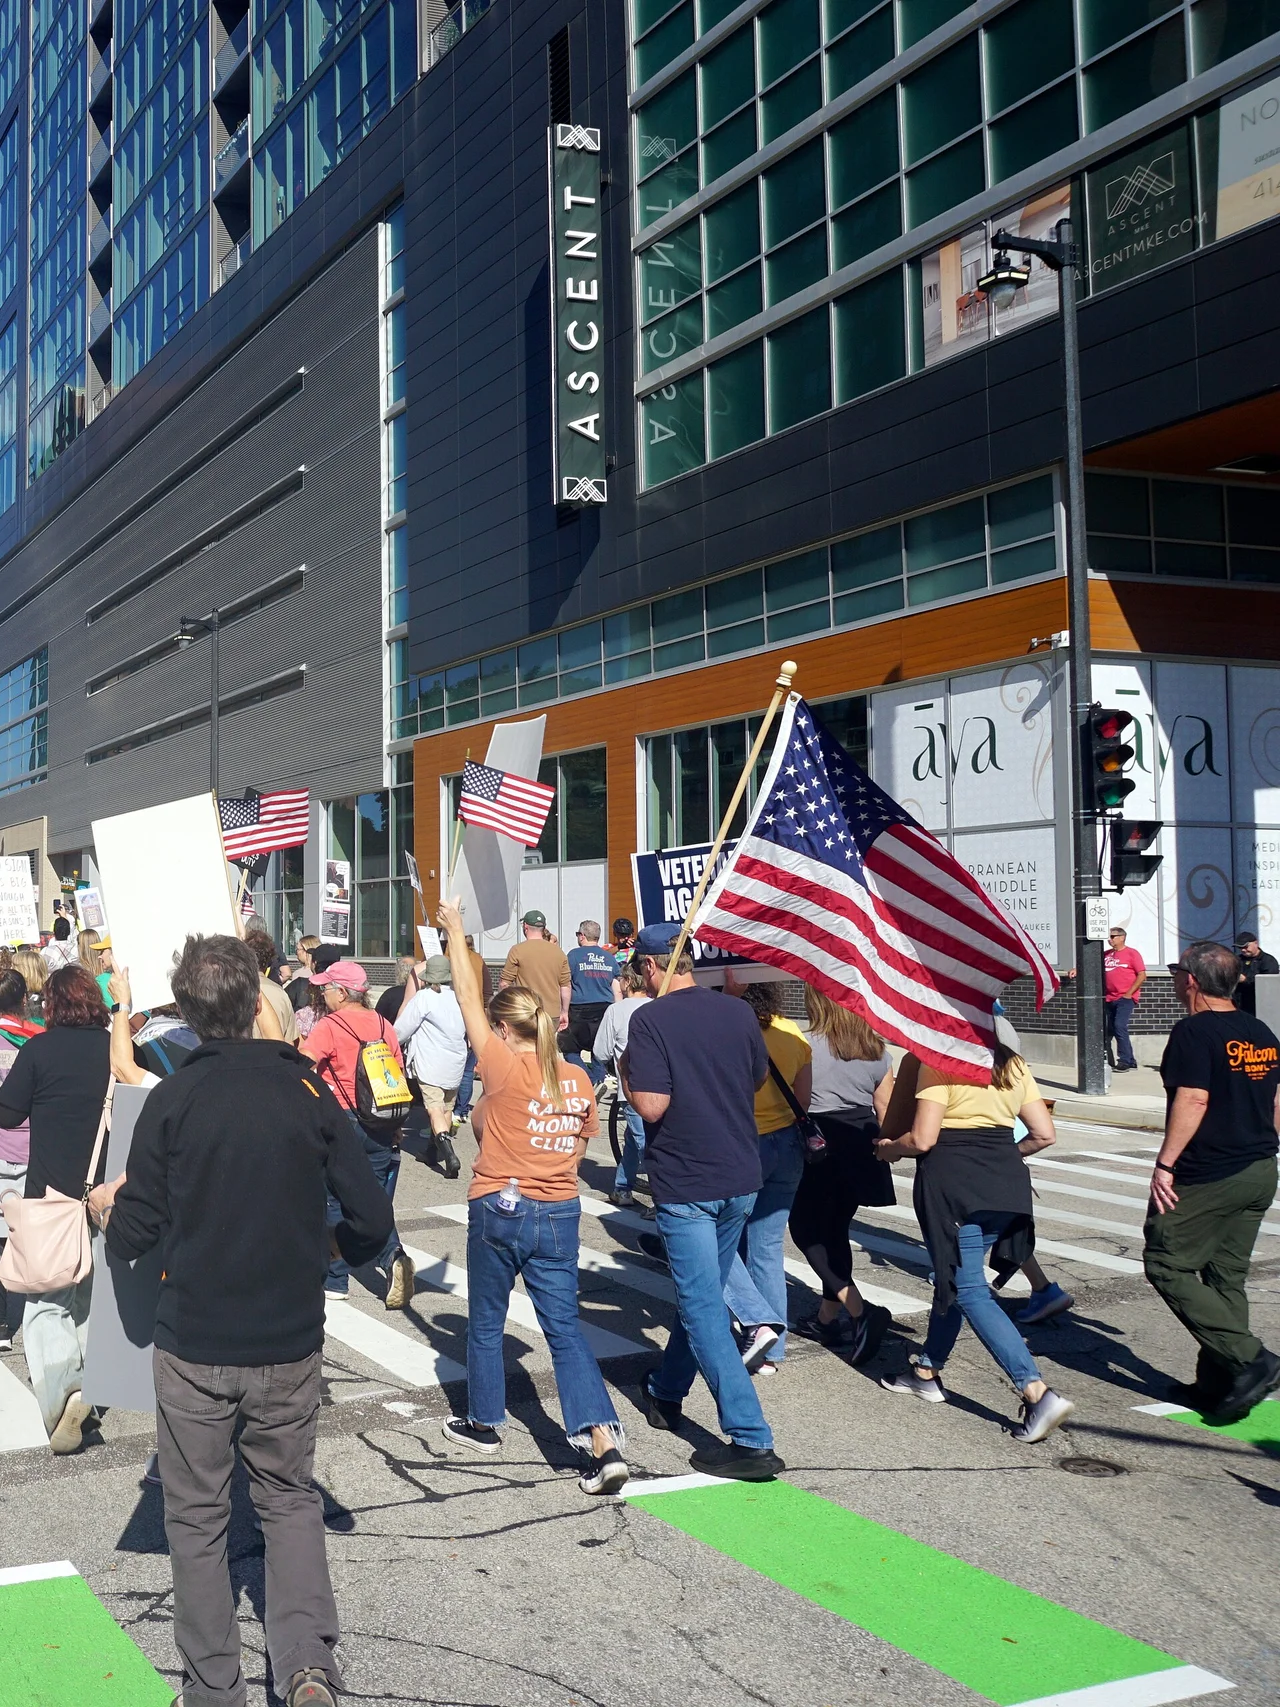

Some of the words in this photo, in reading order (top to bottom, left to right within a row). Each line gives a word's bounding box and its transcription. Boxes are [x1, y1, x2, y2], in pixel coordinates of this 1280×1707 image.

[1107, 195, 1176, 236] ASCENT
[1134, 223, 1150, 234] MKE
[1073, 212, 1208, 281] ASCENTMKE.COM
[564, 186, 600, 441] ASCENT
[4, 860, 28, 872] SIGN
[968, 861, 1036, 876] RRANEAN
[10, 877, 27, 887] BIG
[982, 879, 1037, 893] MIDDLE
[8, 905, 18, 914] ALL
[20, 904, 32, 914] THE
[1003, 897, 1037, 910] SINE
[1022, 923, 1051, 931] AUKEE
[4, 929, 27, 940] HERE
[587, 952, 605, 963] Pabst
[579, 962, 593, 971] Blue
[593, 962, 613, 972] Ribbon
[1226, 1040, 1278, 1066] Falcon
[1244, 1064, 1270, 1072] BOWL
[540, 1080, 578, 1098] ATI
[527, 1097, 591, 1116] RAIST
[526, 1115, 581, 1134] MOMS
[530, 1135, 576, 1154] CLUB
